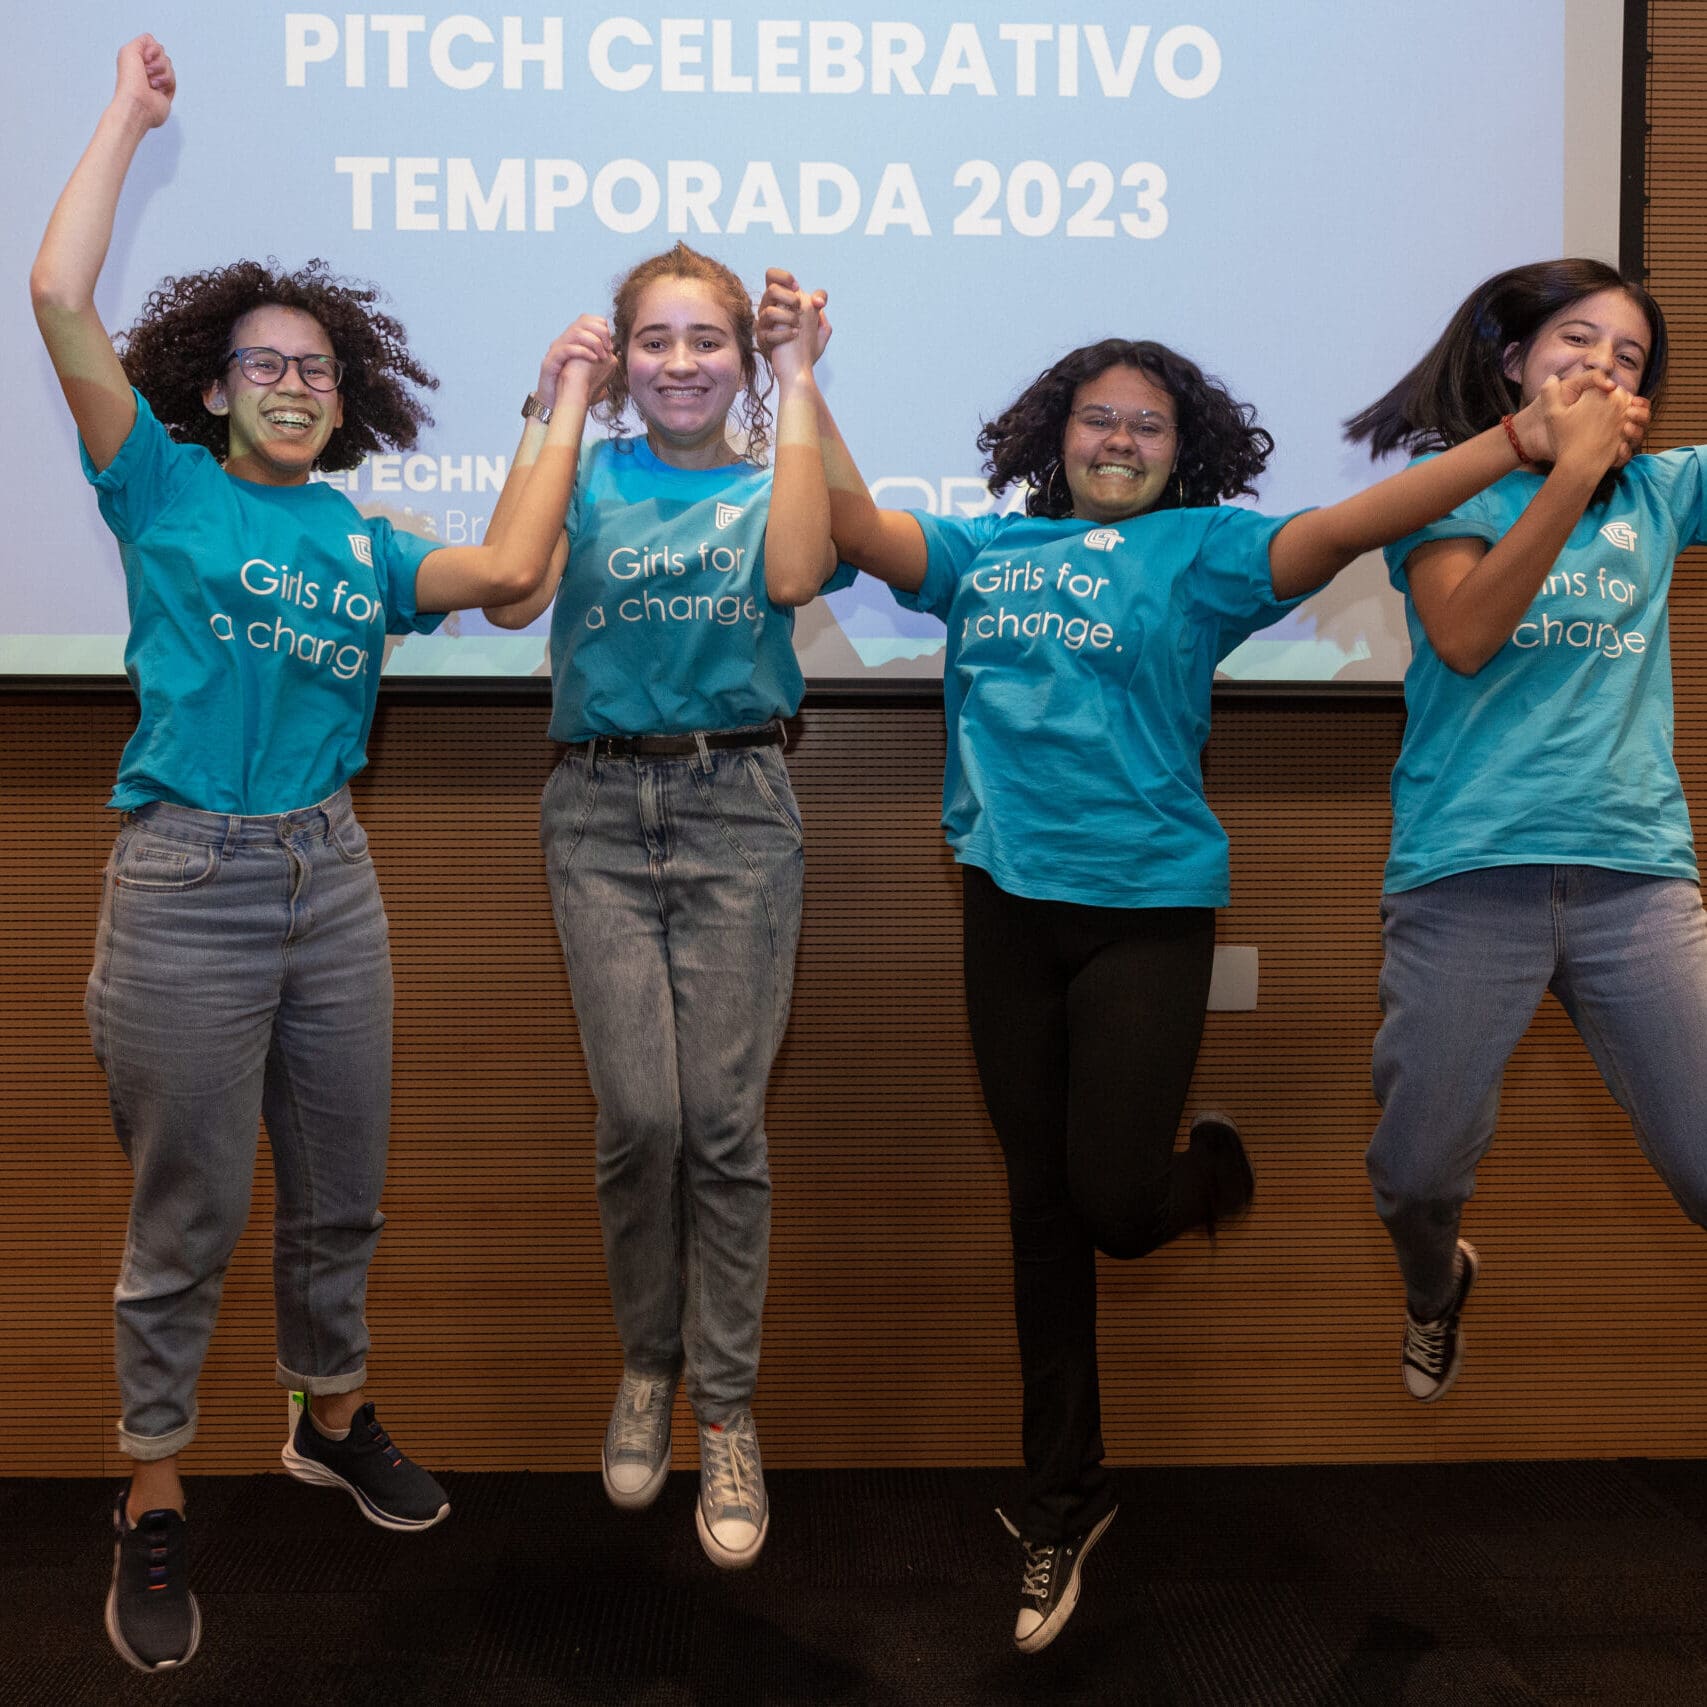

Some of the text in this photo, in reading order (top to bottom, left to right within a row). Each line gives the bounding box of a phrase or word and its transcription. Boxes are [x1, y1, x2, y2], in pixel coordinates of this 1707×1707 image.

[285, 13, 1222, 99] PITCH CELEBRATIVO
[335, 157, 1169, 240] TEMPORADA 2023
[608, 542, 745, 580] Girls for
[972, 560, 1110, 600] Girls for
[240, 558, 382, 624] Girls for
[1596, 567, 1637, 607] for
[209, 613, 235, 641] a
[585, 604, 606, 630] a
